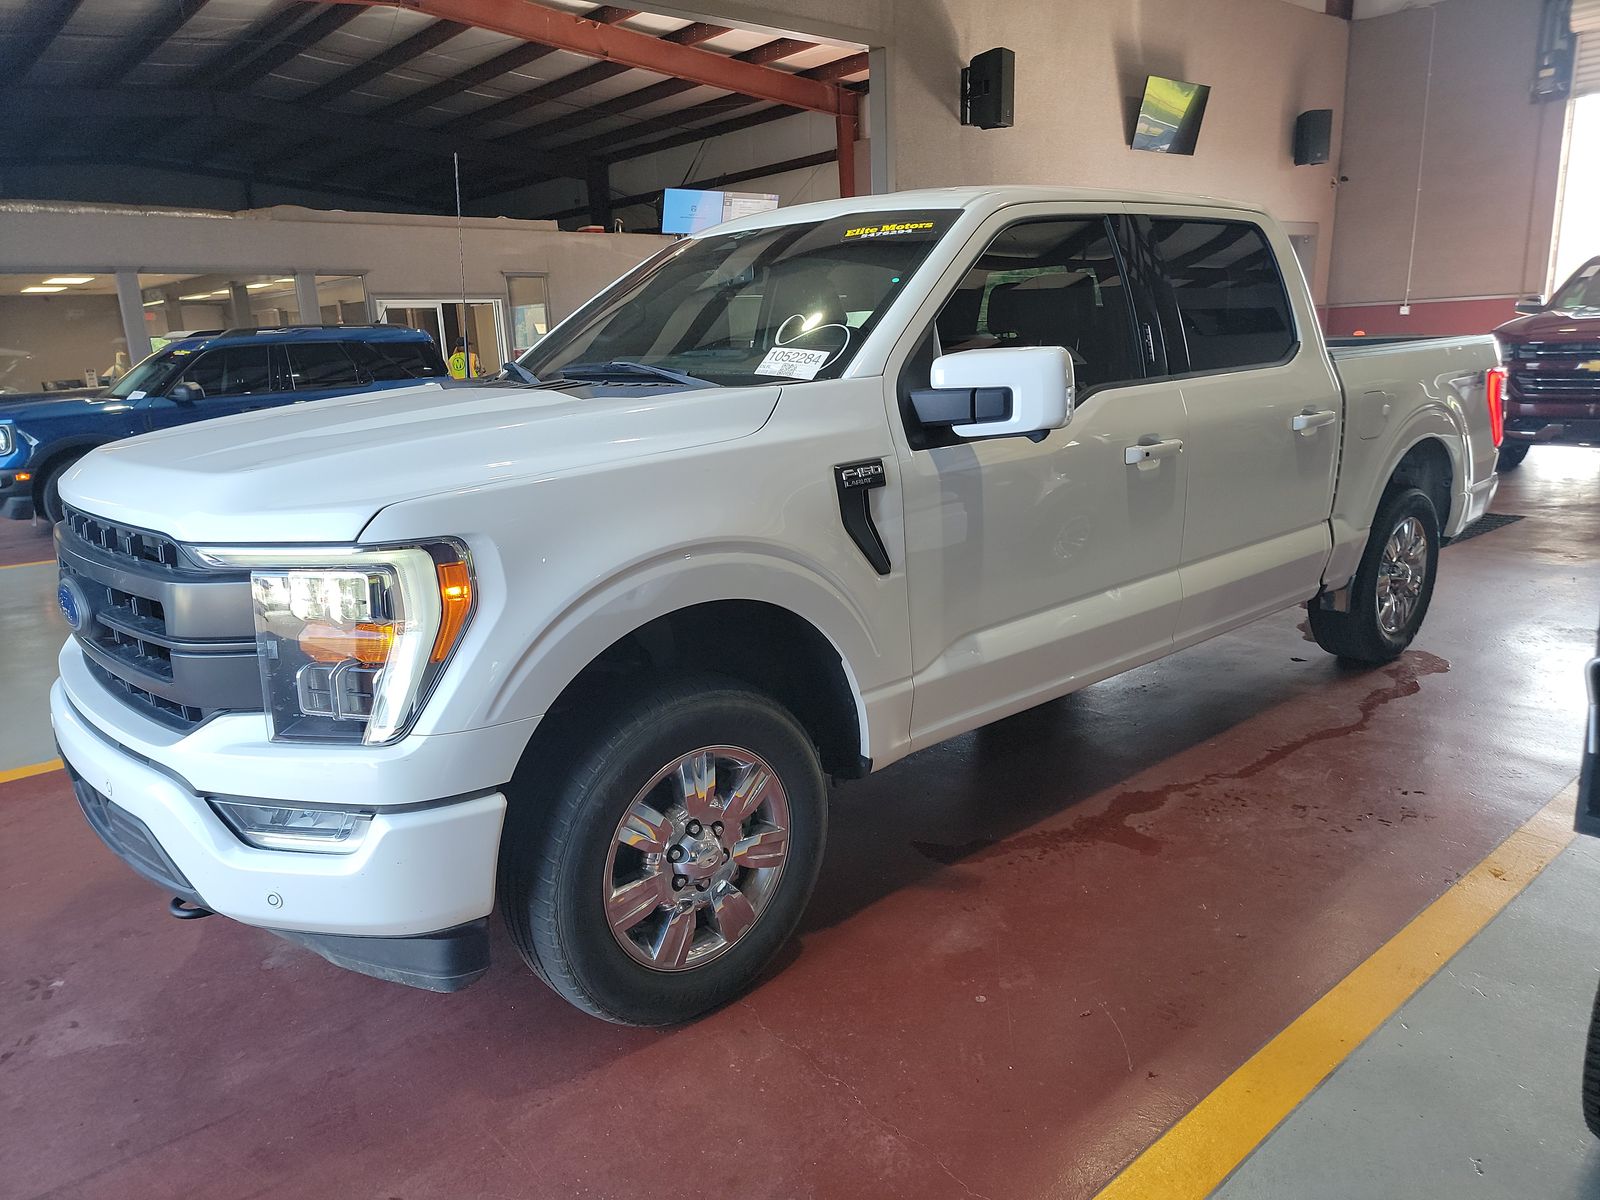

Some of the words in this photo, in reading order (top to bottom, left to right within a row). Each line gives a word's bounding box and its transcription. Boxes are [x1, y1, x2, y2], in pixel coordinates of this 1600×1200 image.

[844, 226, 879, 237] Elite
[881, 222, 934, 232] Motors
[768, 350, 823, 366] 1052284
[841, 464, 883, 481] F-150
